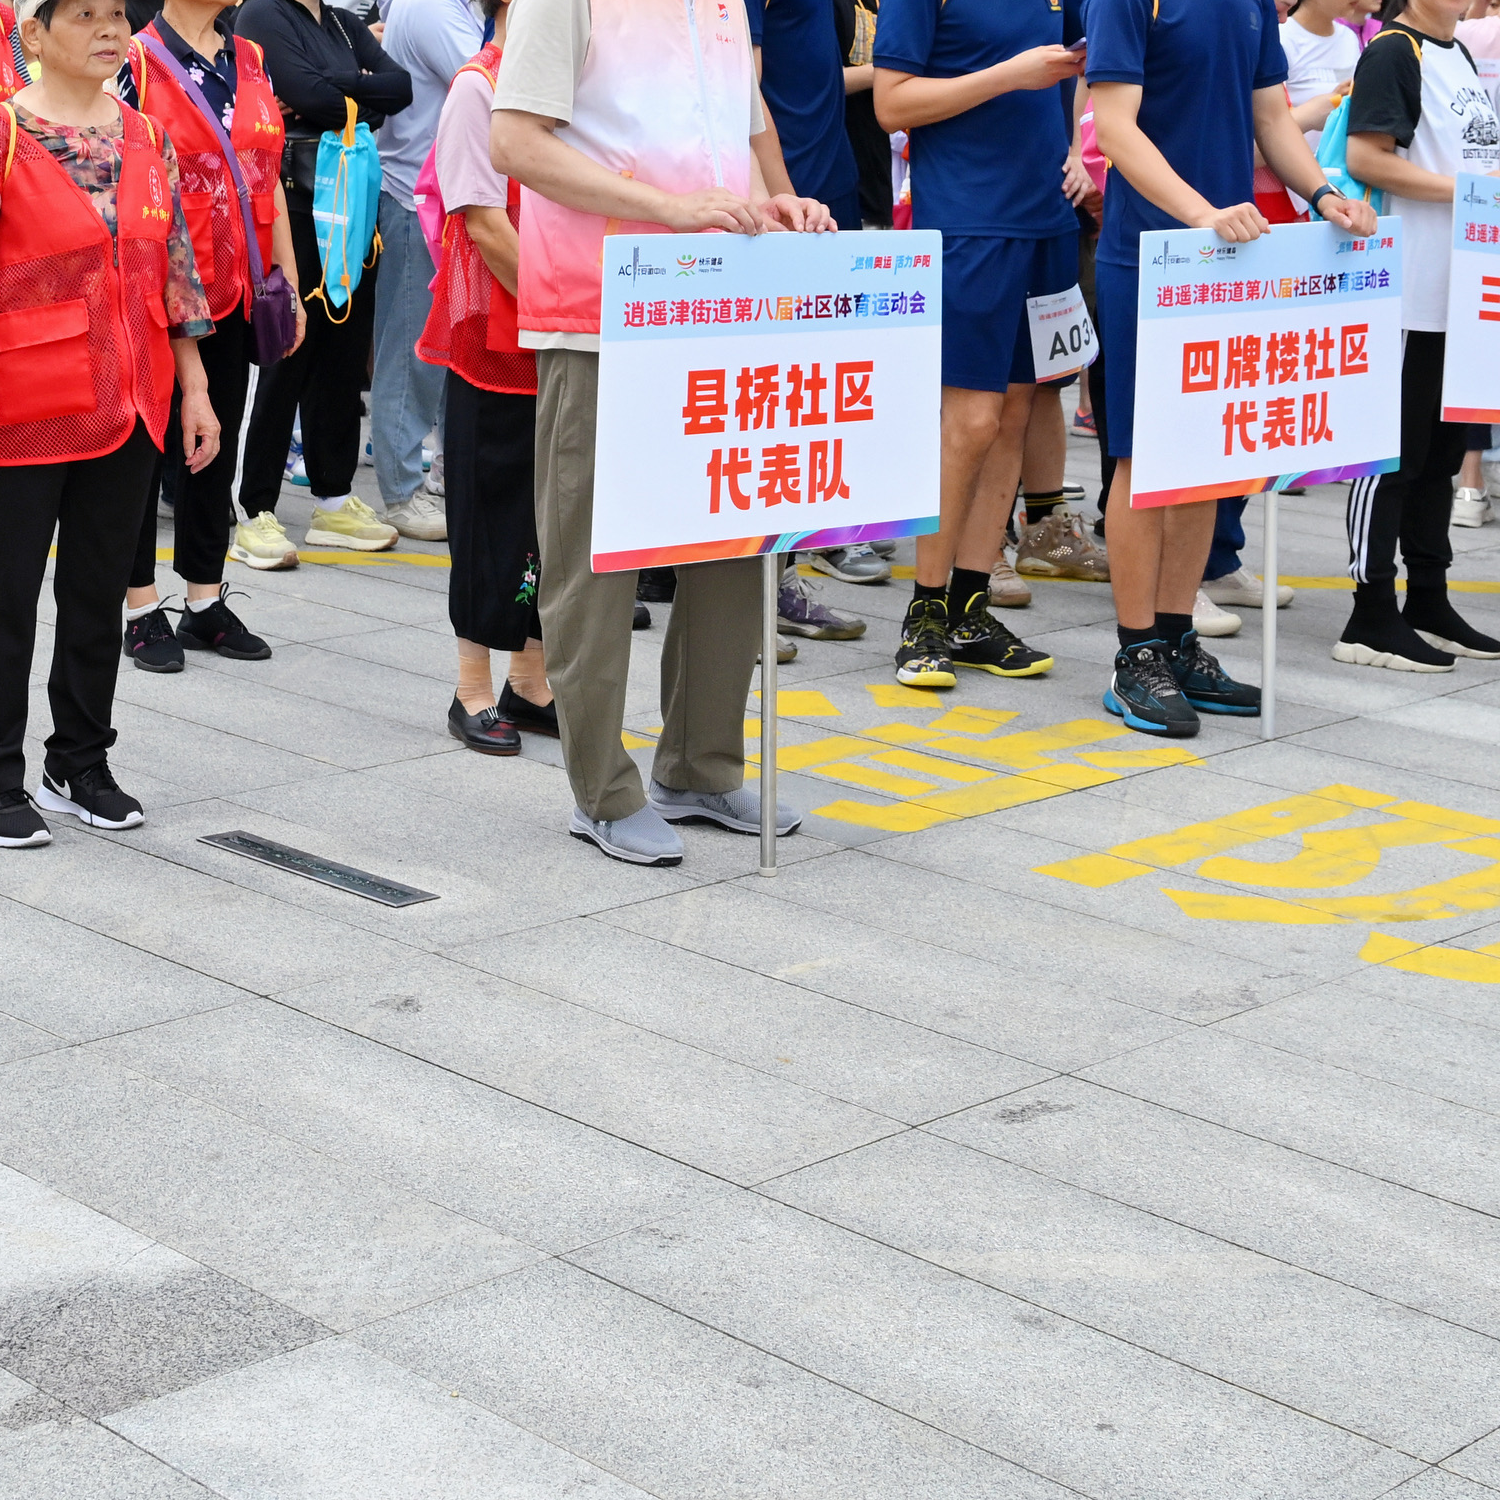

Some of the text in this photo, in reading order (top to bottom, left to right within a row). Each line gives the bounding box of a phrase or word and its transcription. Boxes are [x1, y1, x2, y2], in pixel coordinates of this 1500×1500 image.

[618, 264, 632, 276] AC
[894, 255, 931, 276] 活力庐阳
[1157, 268, 1390, 308] 逍遥津街道第八届社区体育运动会
[623, 291, 926, 328] 逍遥津街道第八届社区体育运动会
[1049, 318, 1094, 360] A03
[1181, 323, 1369, 394] 四牌楼社区
[682, 360, 874, 436] 县桥社区
[1222, 392, 1333, 456] 代表队
[706, 439, 850, 514] 代表队
